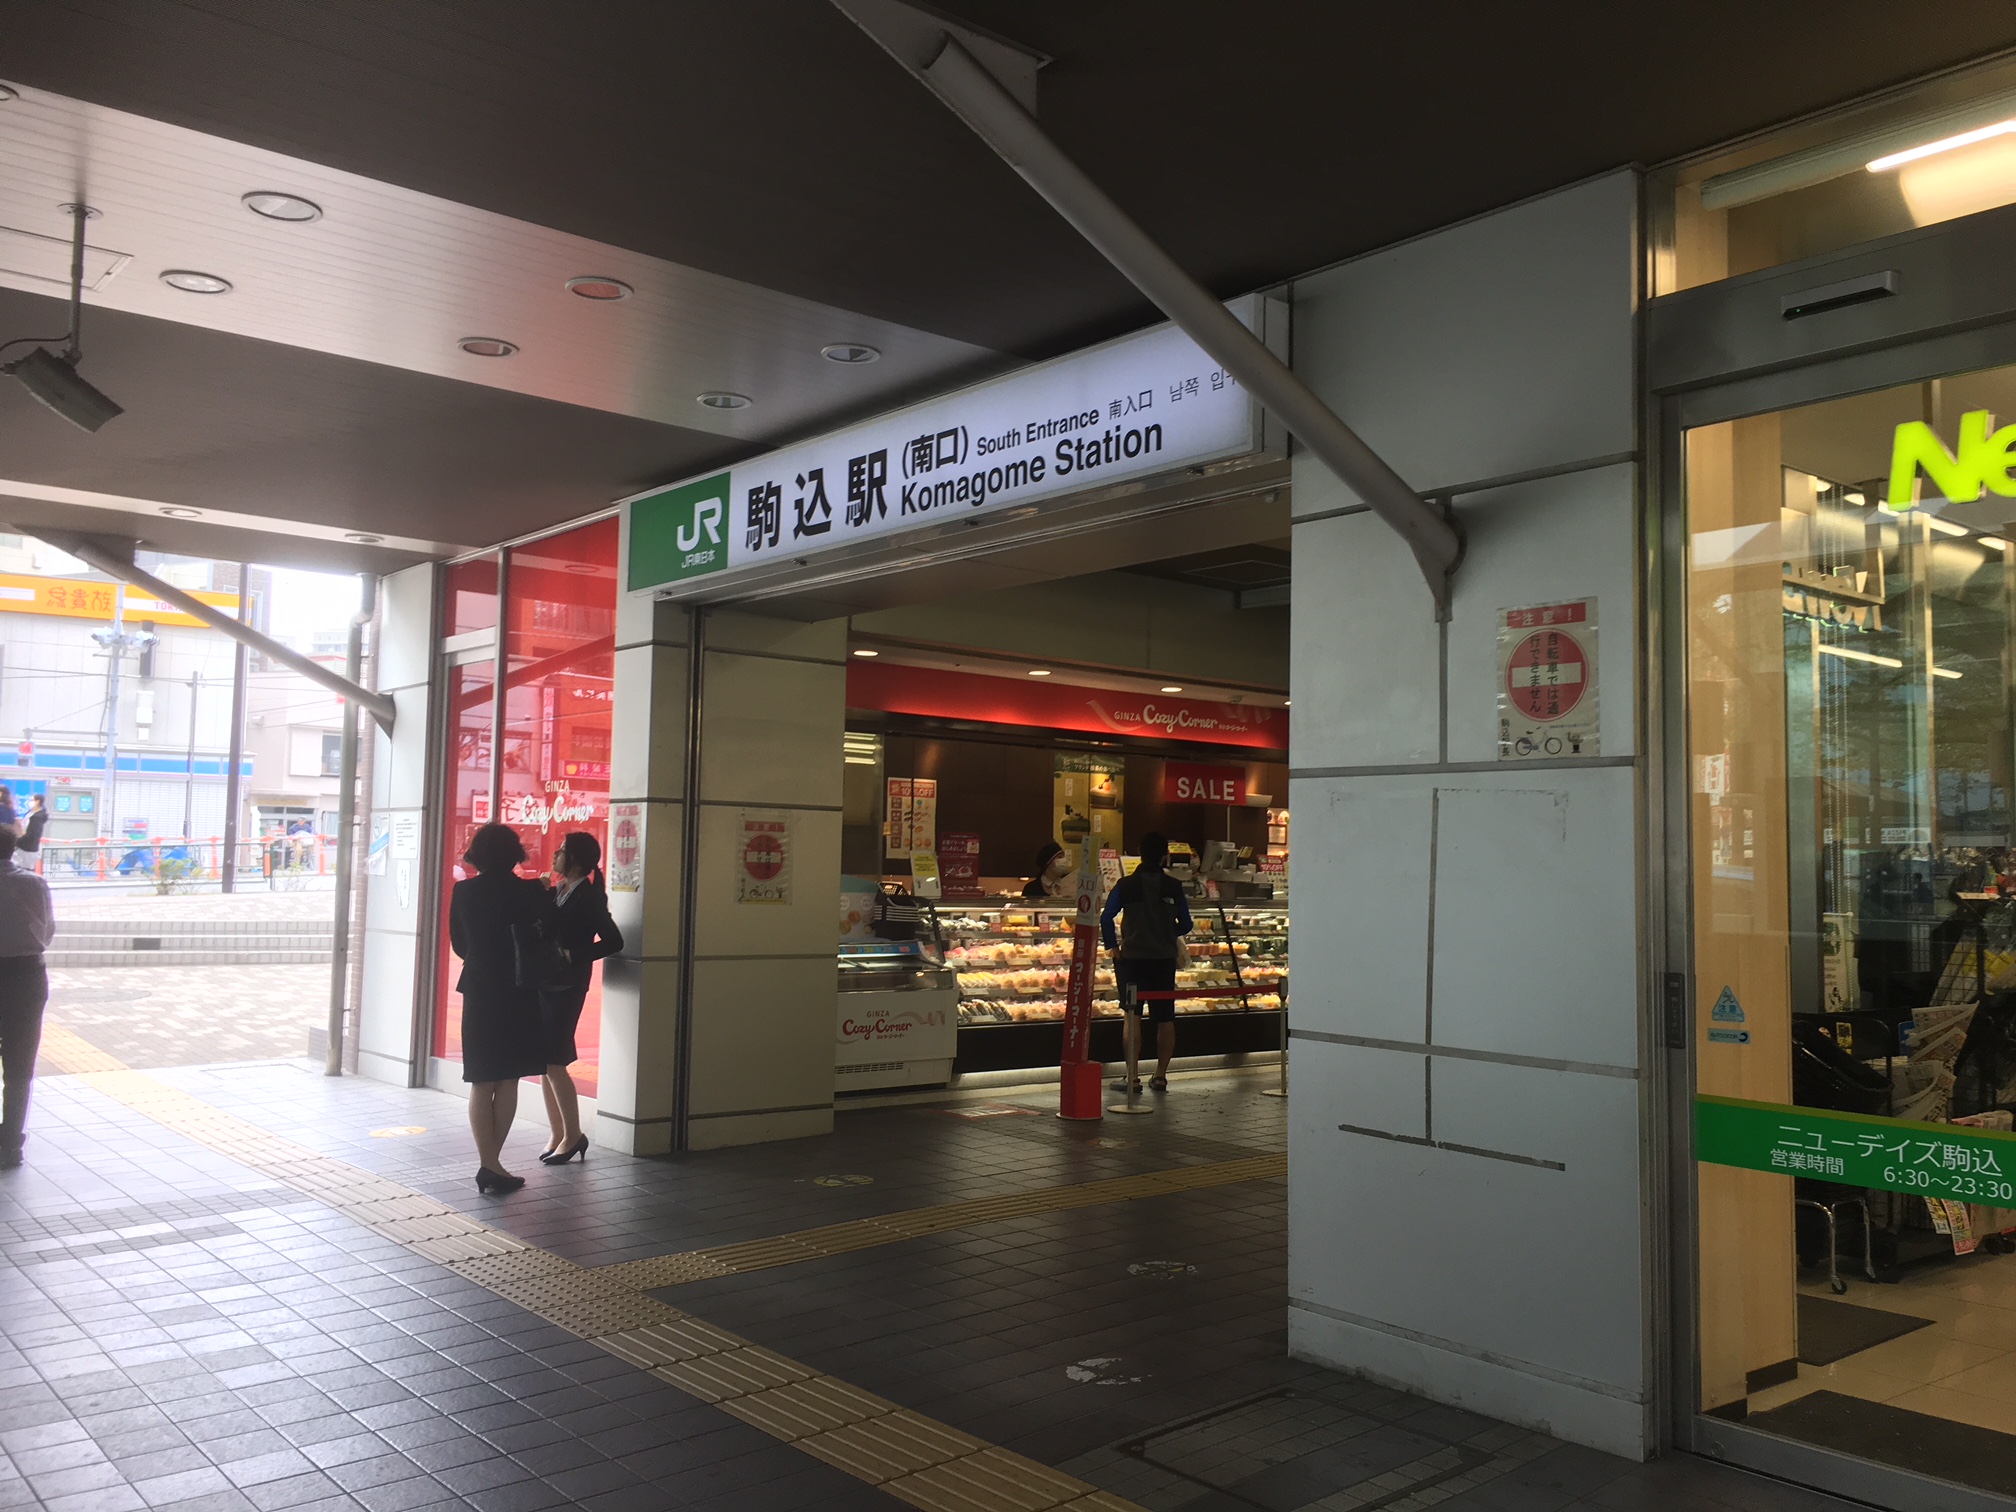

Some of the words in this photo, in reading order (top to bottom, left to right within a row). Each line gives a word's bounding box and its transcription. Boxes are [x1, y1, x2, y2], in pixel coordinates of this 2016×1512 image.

[746, 448, 888, 551] 駒込駅
[902, 425, 969, 479] (南口)
[977, 428, 1021, 456] South
[1026, 409, 1099, 444] Entrance
[1109, 389, 1153, 421] 南入口
[1169, 377, 1200, 402] 남쪽
[901, 455, 1046, 516] Komagome
[1055, 423, 1162, 476] Station
[677, 497, 722, 551] JR
[681, 549, 716, 569] JR東日本
[46, 586, 112, 613] 鳥貴族
[1113, 710, 1141, 722] GINZA
[1143, 704, 1178, 733] Cozy
[1178, 709, 1218, 729] Corner
[545, 780, 570, 793] GINZA
[1177, 776, 1235, 801] SALE
[522, 794, 553, 835] Cozy
[553, 795, 594, 823] Corner
[866, 1010, 890, 1018] GINZA
[842, 1019, 875, 1040] Cozy
[875, 1019, 912, 1033] Corner
[1770, 1148, 1844, 1176] 営業時間
[1778, 1125, 2003, 1177] ニューデイズ駒込
